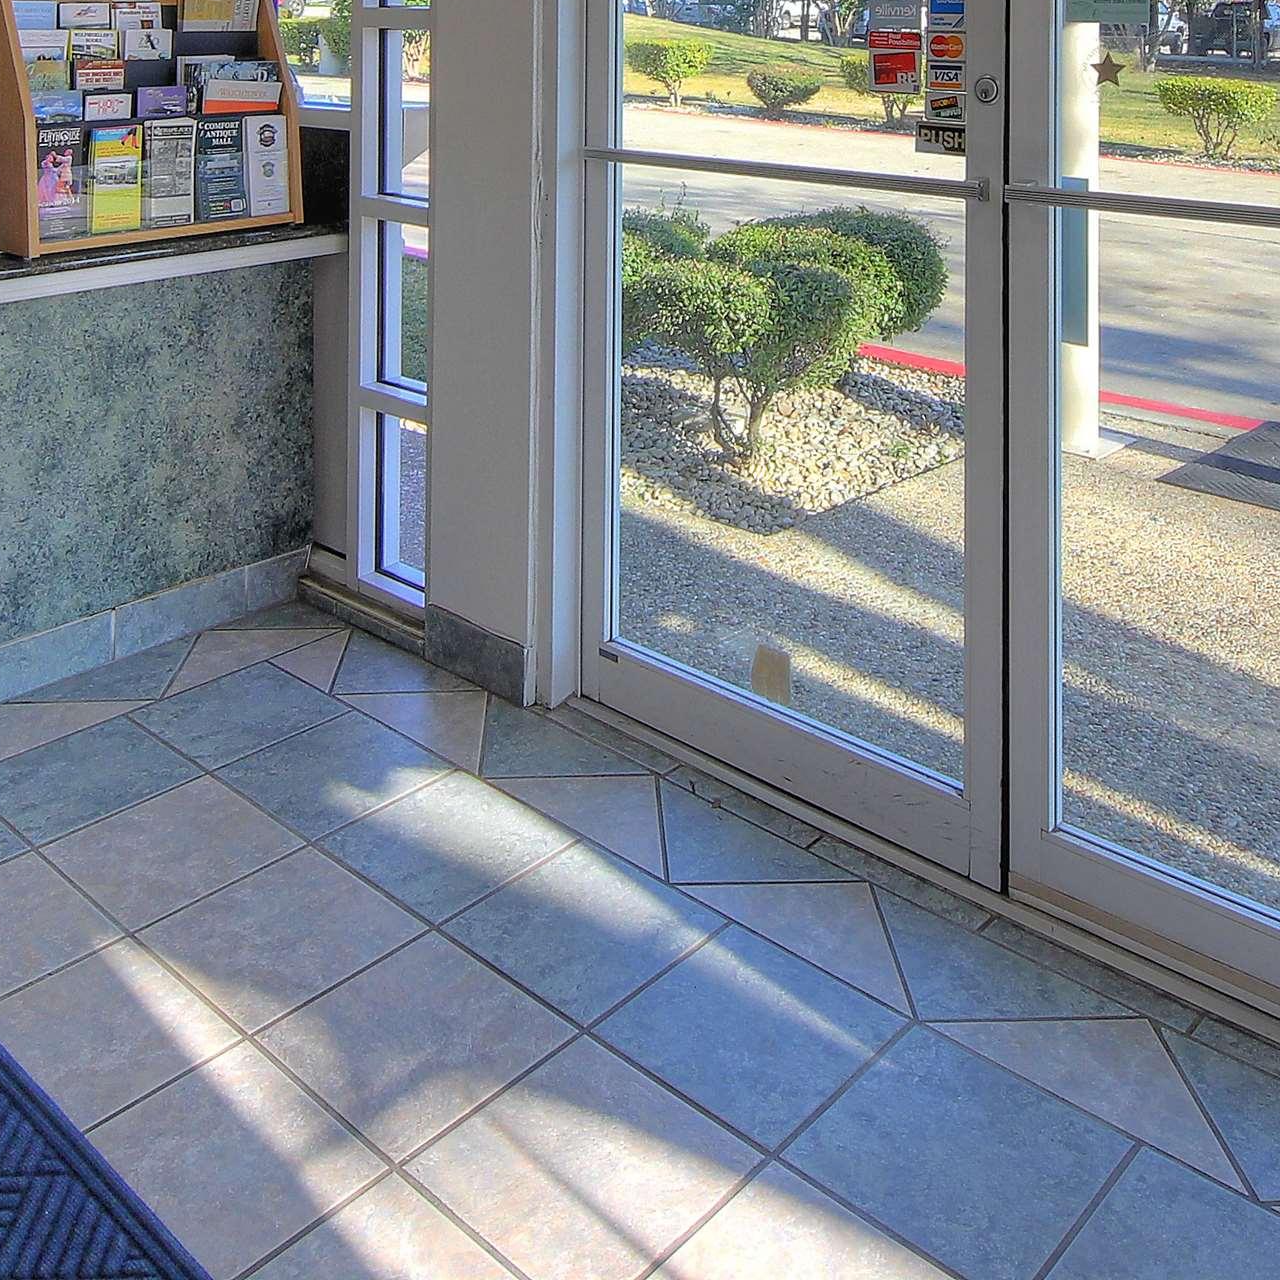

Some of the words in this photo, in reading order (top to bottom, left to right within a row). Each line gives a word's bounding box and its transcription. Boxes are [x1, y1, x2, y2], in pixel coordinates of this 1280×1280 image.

[930, 43, 963, 51] MasterCard
[934, 71, 959, 82] VISA
[204, 121, 240, 130] COMFORT
[205, 130, 238, 138] ANTIQUE
[212, 137, 233, 145] MALL
[921, 128, 965, 149] PUSH
